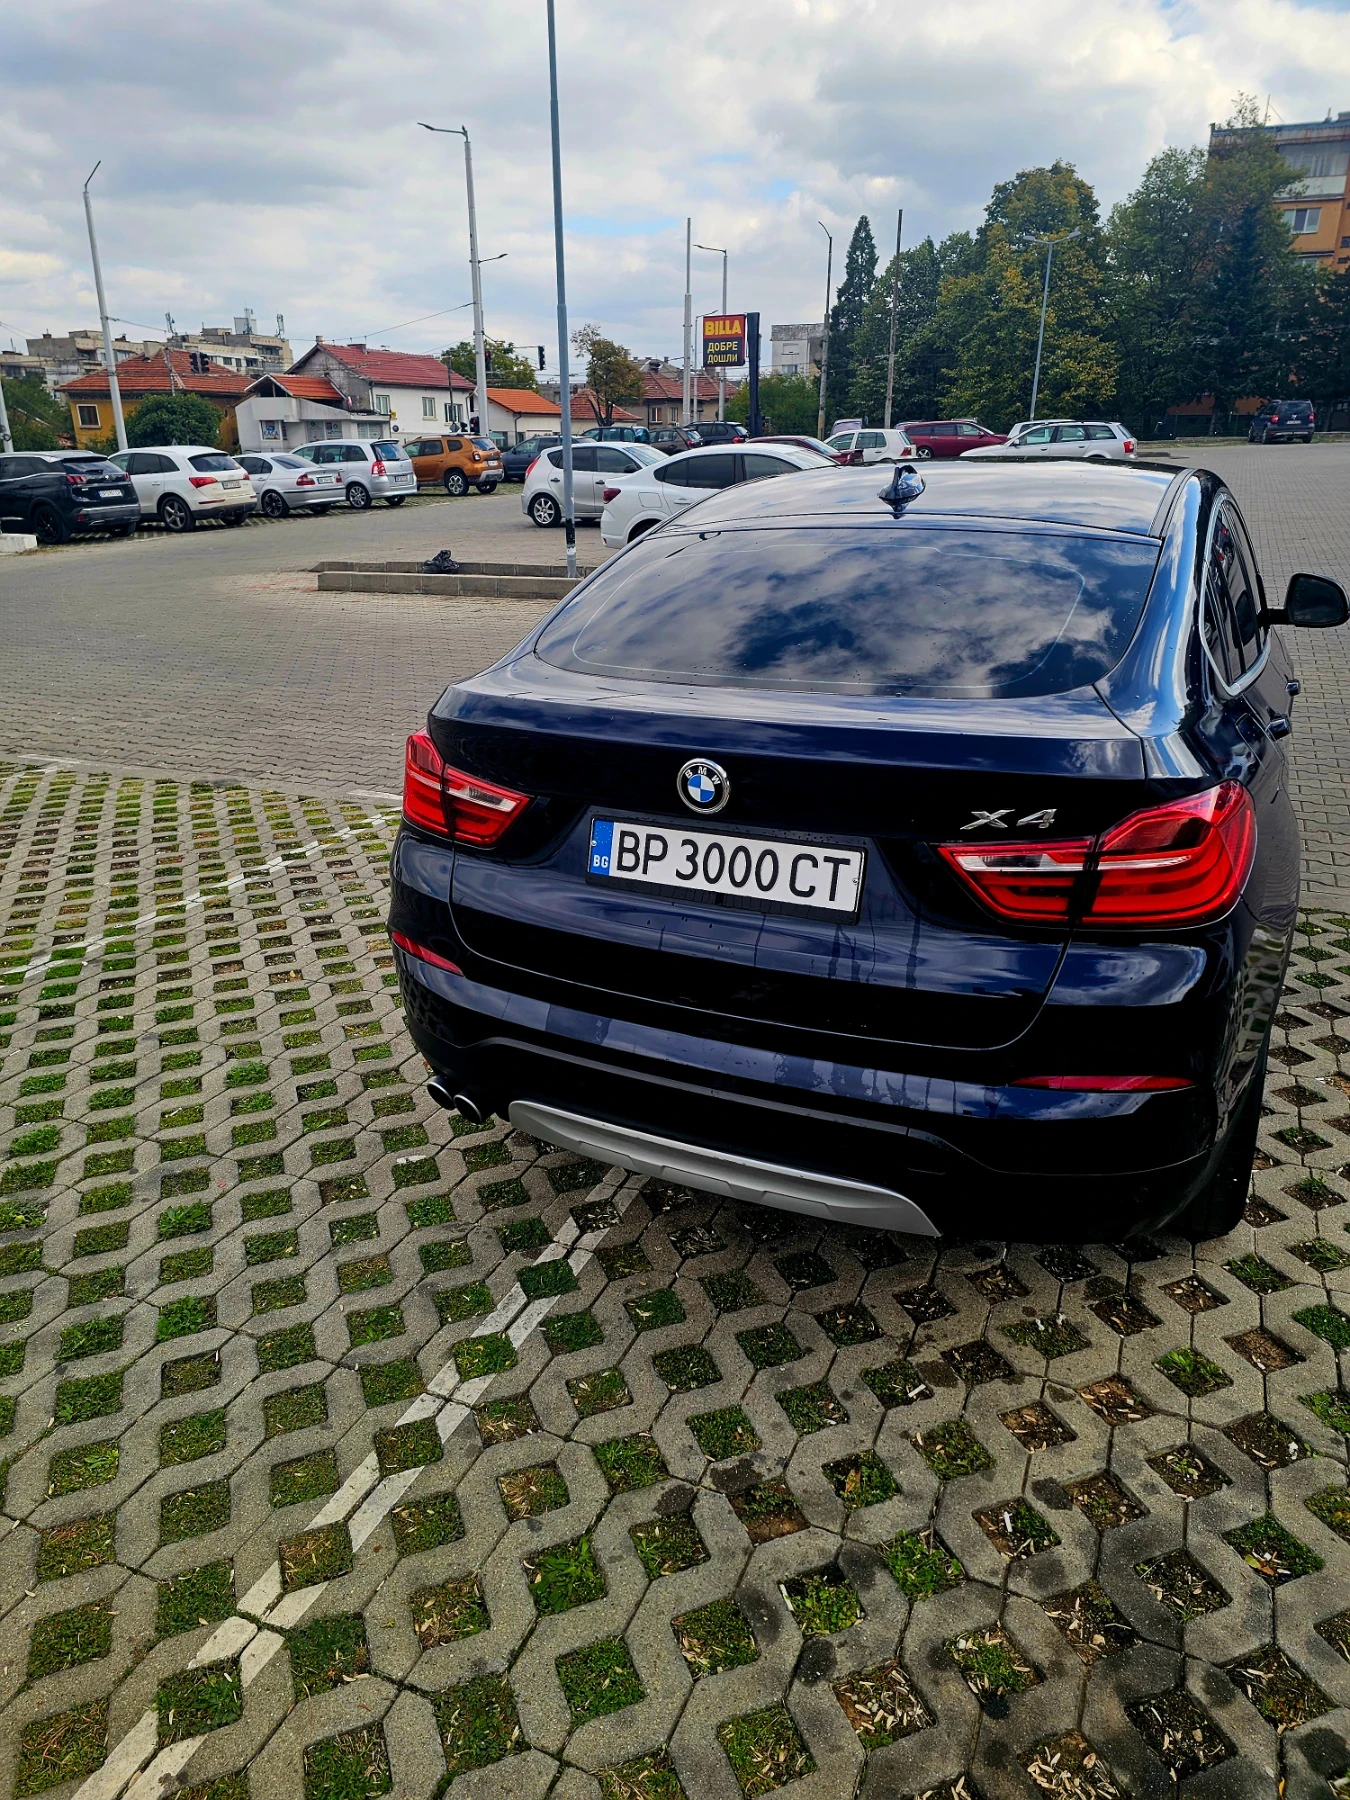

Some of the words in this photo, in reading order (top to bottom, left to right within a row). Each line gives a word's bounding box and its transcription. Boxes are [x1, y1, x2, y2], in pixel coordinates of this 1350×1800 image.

[704, 320, 742, 336] BILLA
[707, 341, 738, 354] ДОБРЕ
[707, 353, 738, 365] ДОШЛИ
[685, 765, 721, 786] BMW
[592, 854, 609, 869] BG
[616, 830, 668, 875] BP
[675, 838, 779, 892] 3000
[789, 853, 851, 902] CT
